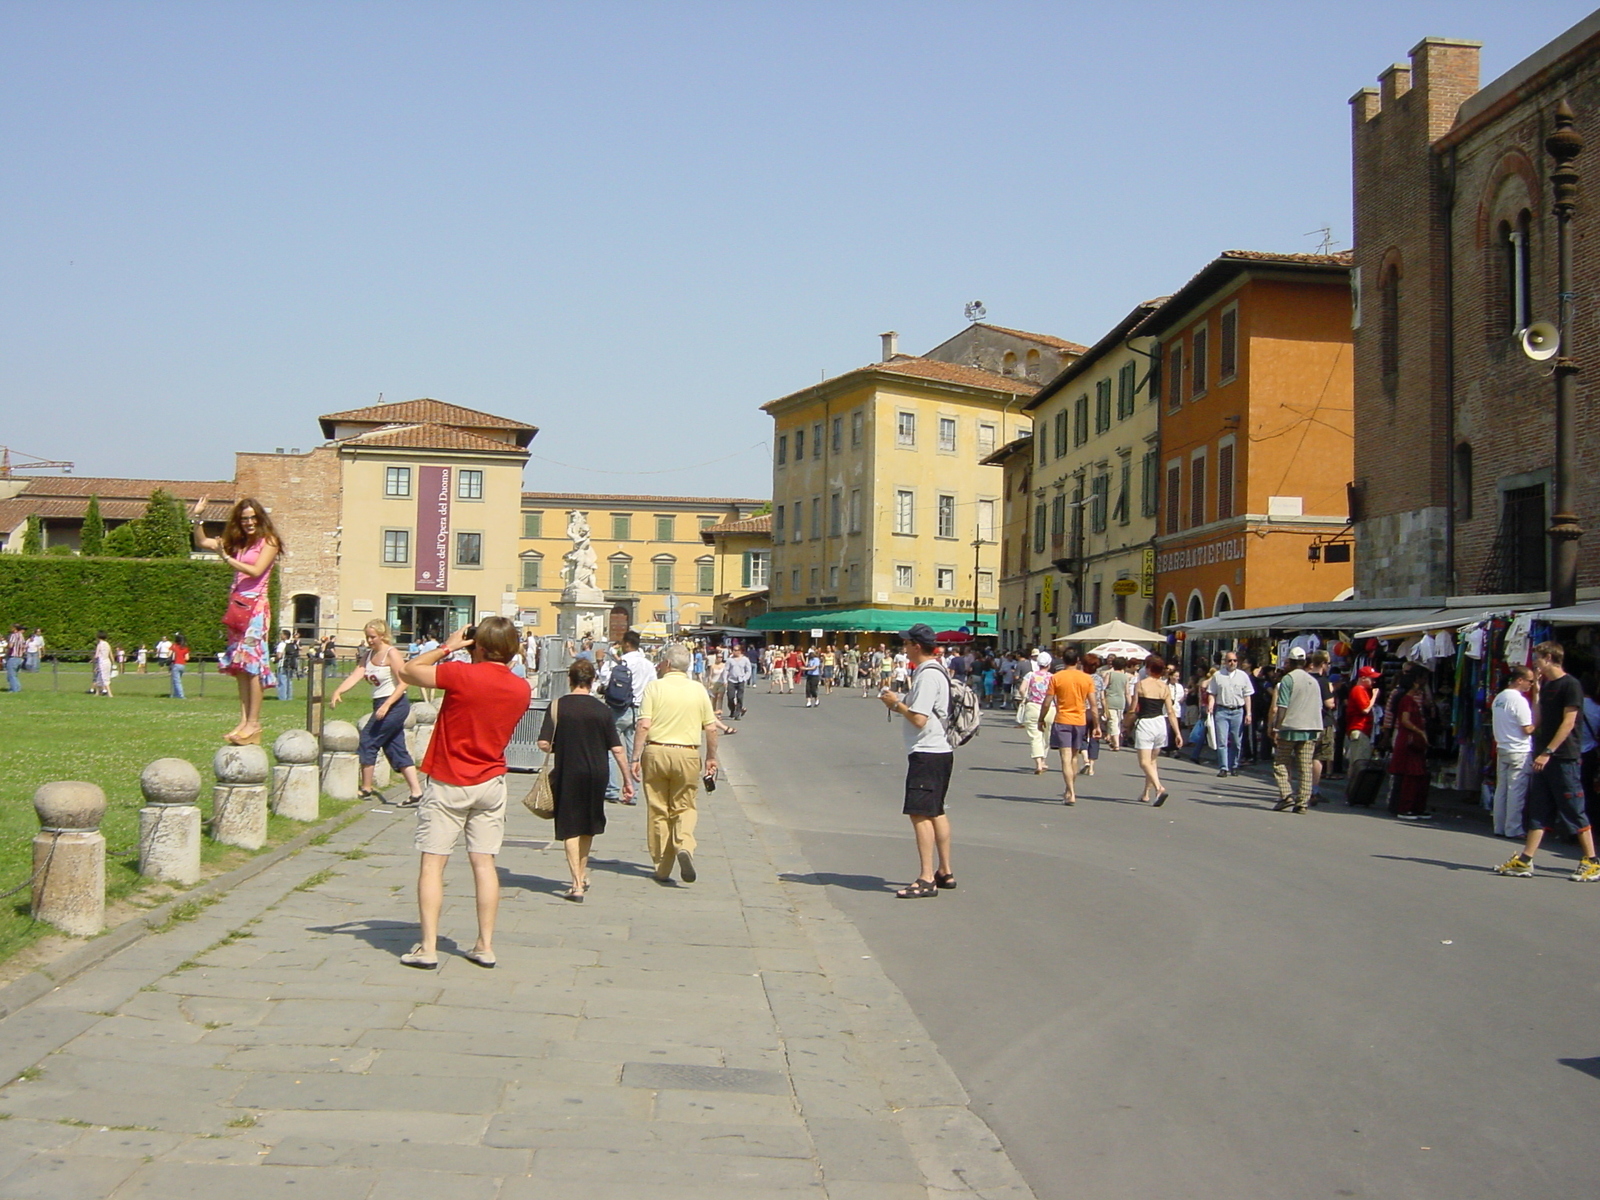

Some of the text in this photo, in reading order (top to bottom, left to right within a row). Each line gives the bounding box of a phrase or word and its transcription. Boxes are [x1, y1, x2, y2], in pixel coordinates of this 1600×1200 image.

[435, 468, 449, 588] Museo dell'Opera del Duomo
[914, 597, 935, 606] BAR
[1075, 613, 1092, 624] TAXI
